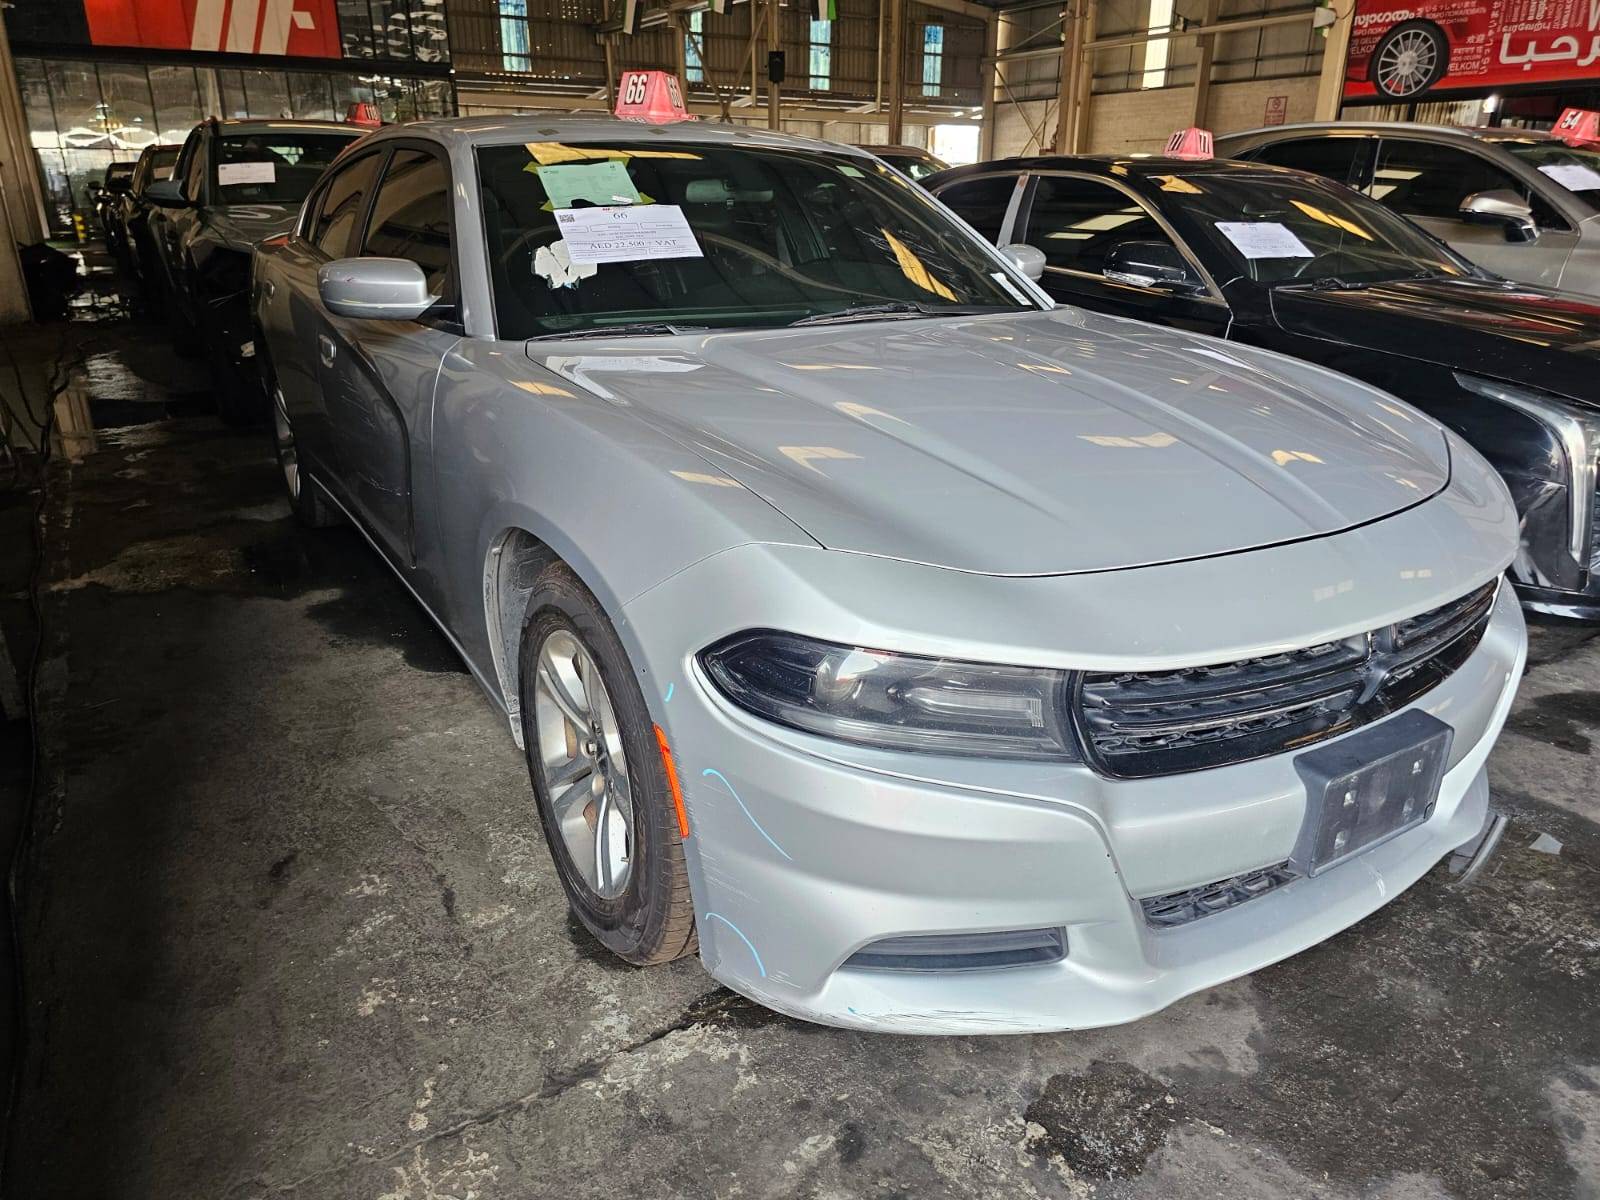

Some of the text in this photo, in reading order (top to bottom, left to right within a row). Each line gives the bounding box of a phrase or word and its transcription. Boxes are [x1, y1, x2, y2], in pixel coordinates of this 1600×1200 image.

[1499, 33, 1600, 71] رحبا
[1448, 61, 1480, 71] ELKOM
[625, 74, 648, 104] 66
[1560, 111, 1583, 130] 54
[655, 239, 678, 247] VAT
